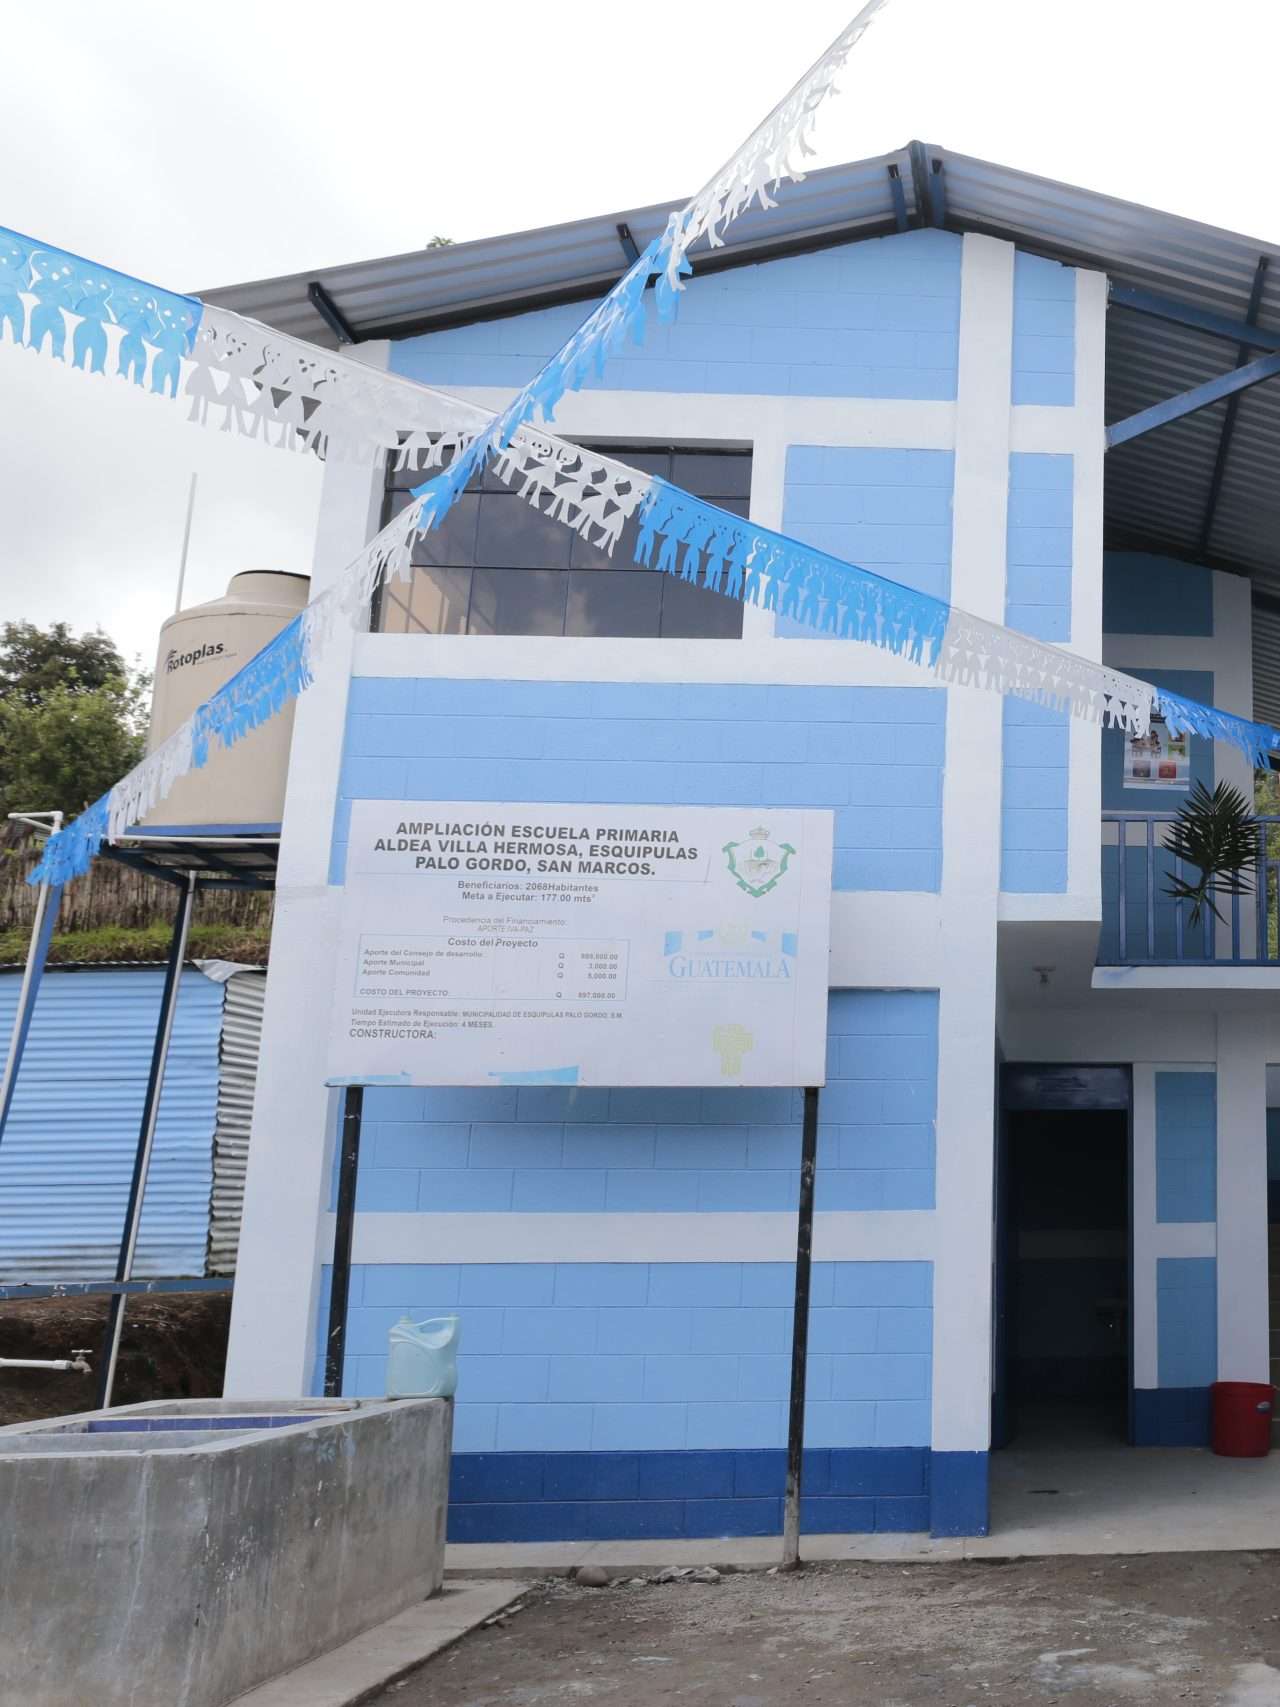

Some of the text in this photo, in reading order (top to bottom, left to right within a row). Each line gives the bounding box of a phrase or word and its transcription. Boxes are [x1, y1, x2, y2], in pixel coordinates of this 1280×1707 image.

[167, 643, 224, 673] Rotoplas
[396, 821, 679, 843] AMPLIACIÓN ESCUELA PRIMARIA
[374, 839, 698, 860] ALDEA VILLA HERMOSA, ESQUIPULAS
[415, 856, 656, 876] PALO GORDO, SAN MARCOS.
[458, 881, 599, 892] Beneficiarios: 2068Habitantes
[462, 892, 485, 900] Meta
[496, 893, 537, 902] Ejecutar:
[541, 894, 571, 902] 177.00
[448, 937, 538, 949] Costo del Proyecto
[364, 949, 388, 957] Aporte
[363, 959, 387, 967] Aporte
[362, 969, 386, 977] Aporte
[349, 1028, 437, 1039] CONSTRUCTORA:
